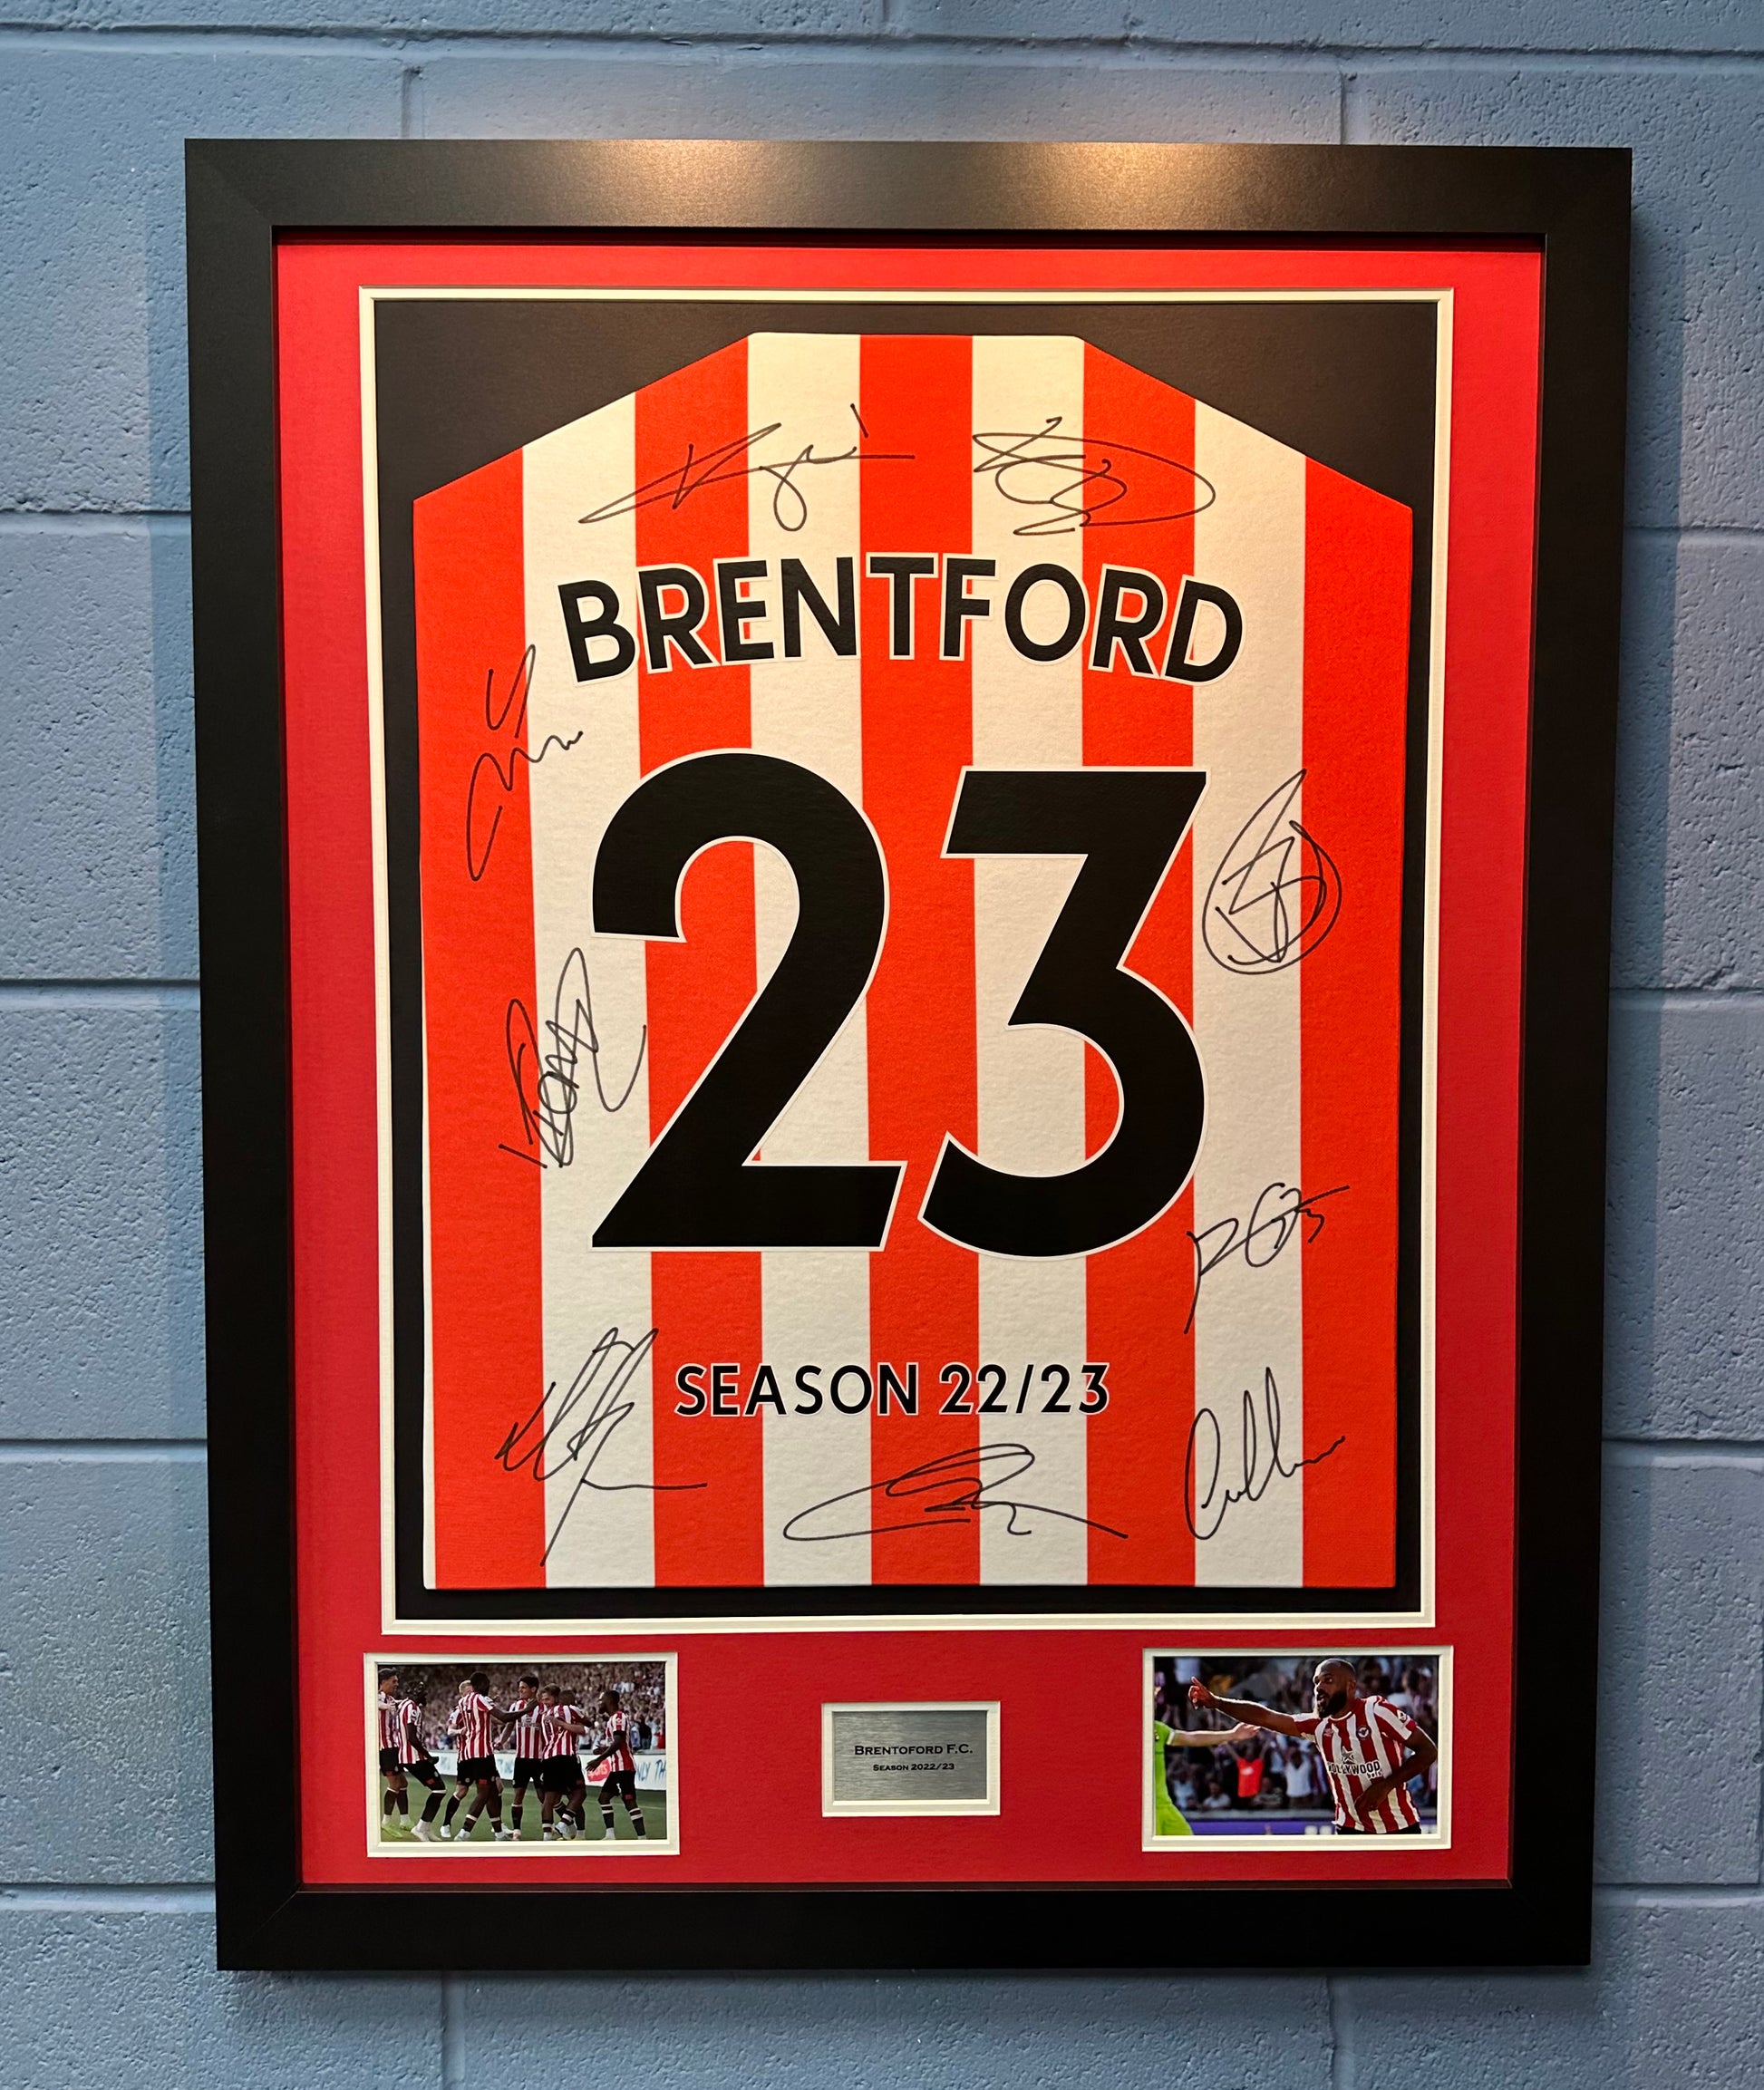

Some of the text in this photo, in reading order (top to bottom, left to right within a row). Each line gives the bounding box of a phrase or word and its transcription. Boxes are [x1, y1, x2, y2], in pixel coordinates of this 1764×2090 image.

[557, 553, 1245, 685] BRENTFORD
[590, 749, 1208, 1261] 23
[675, 1363, 1110, 1416] SEASON 22/23
[854, 1743, 974, 1756] BRENTOFORD F.C.
[873, 1763, 955, 1772] SEASON 2022/23
